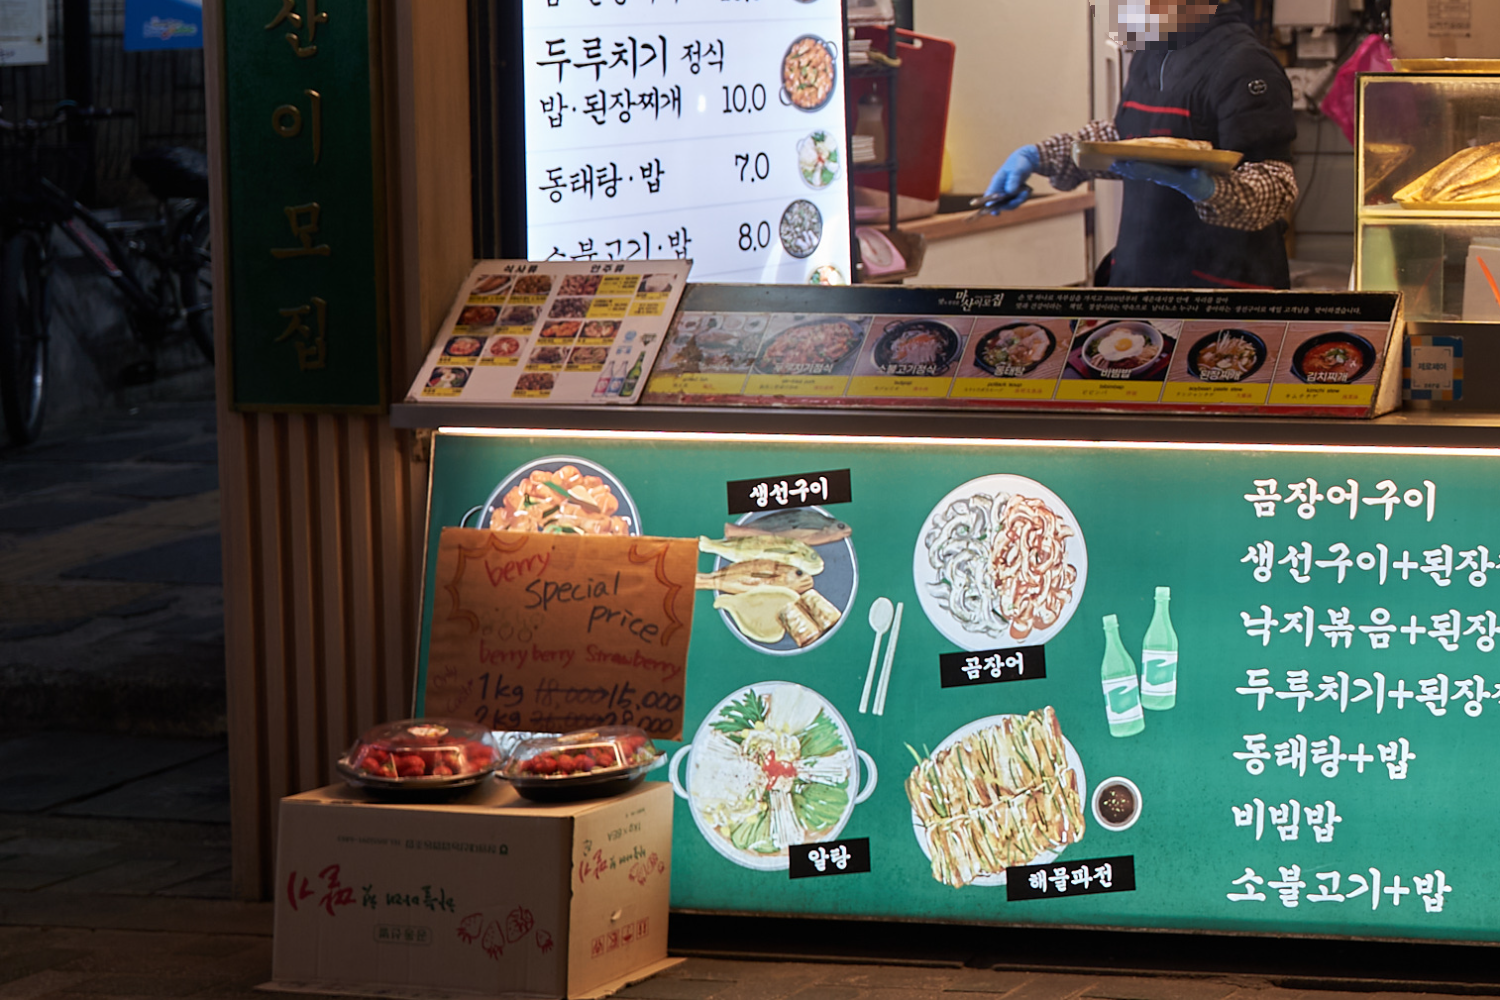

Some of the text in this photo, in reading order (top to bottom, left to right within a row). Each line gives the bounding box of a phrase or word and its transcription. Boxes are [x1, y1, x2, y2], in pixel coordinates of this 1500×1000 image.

[536, 34, 725, 83] 두루치기 정식
[722, 83, 767, 114] 10.0
[734, 152, 770, 183] 7.0
[738, 220, 771, 251] 8.0
[1306, 371, 1349, 383] 김치찌개
[748, 476, 829, 508] 생선구이
[1243, 478, 1437, 522] 곰장어구이
[484, 551, 552, 588] berry
[587, 604, 660, 644] price
[479, 639, 529, 670] berry
[530, 642, 576, 670] berry
[961, 652, 1025, 680] 곰장어
[1232, 733, 1417, 781] 동태탕+밥
[1231, 797, 1343, 844] 비빔밥
[807, 844, 852, 872] 알탕
[286, 863, 358, 917] 딸기
[1028, 863, 1114, 893] 해물파전
[1226, 863, 1453, 913] 소불고기+밥
